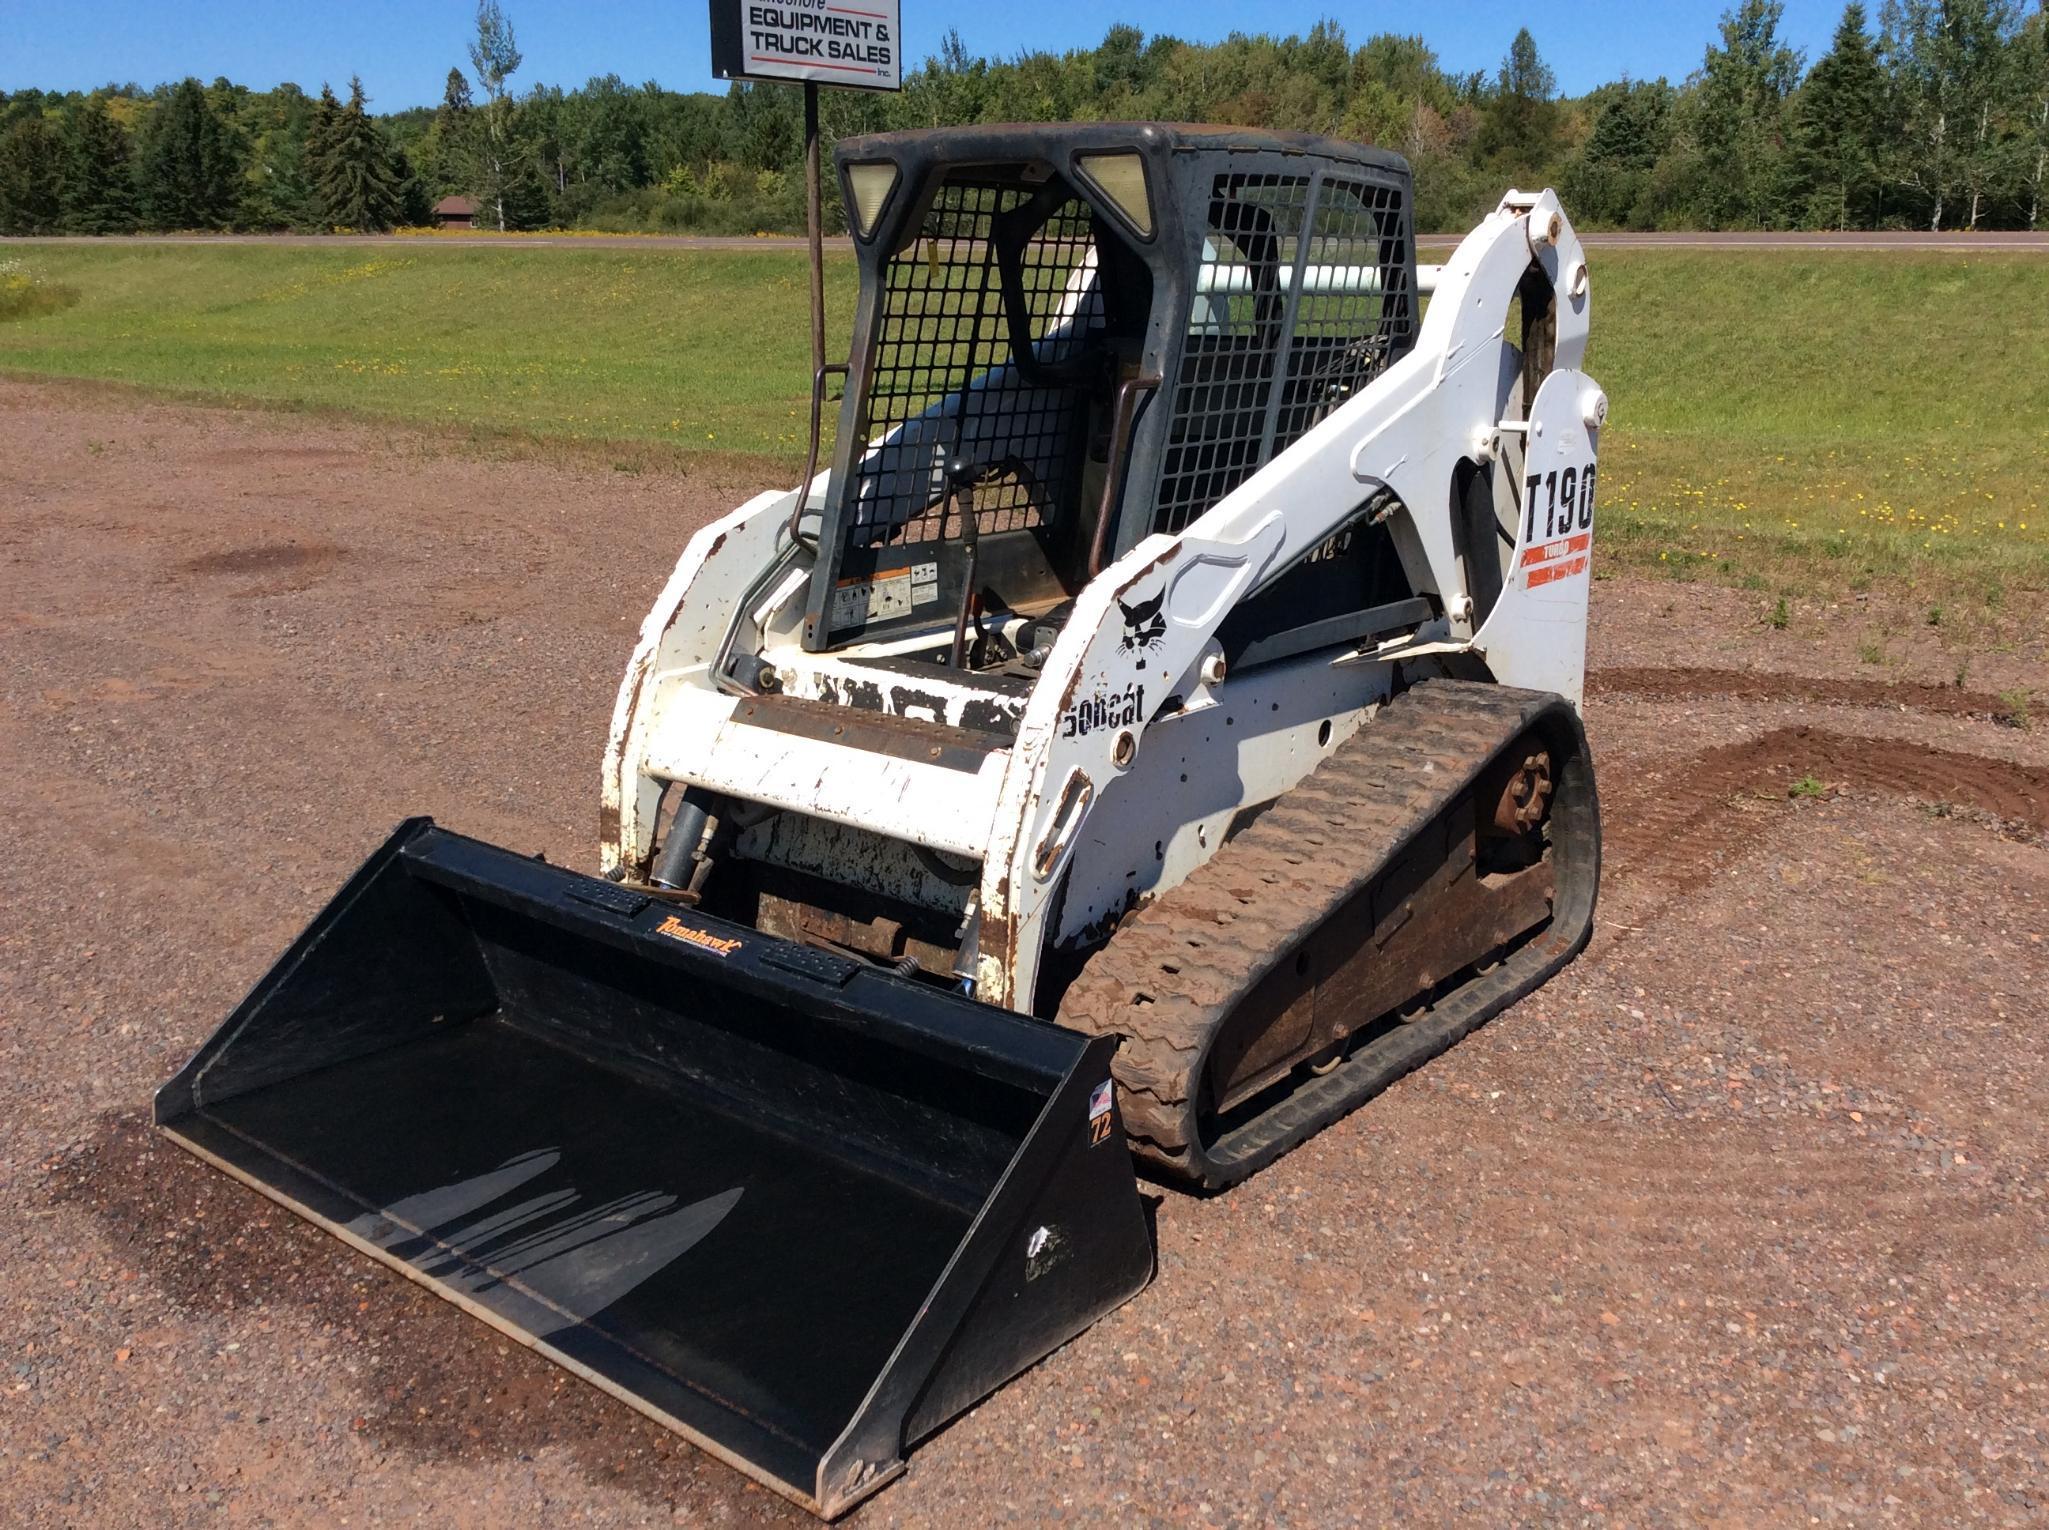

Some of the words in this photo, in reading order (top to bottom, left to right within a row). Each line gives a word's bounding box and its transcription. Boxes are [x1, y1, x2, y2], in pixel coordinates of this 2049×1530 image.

[750, 6, 872, 39] EQUIPMENT
[876, 24, 890, 42] &
[750, 31, 824, 57] TRUCK
[828, 40, 891, 65] SALES
[877, 67, 891, 77] Inc.
[1526, 463, 1596, 543] T190
[1091, 1112, 1111, 1144] 72
